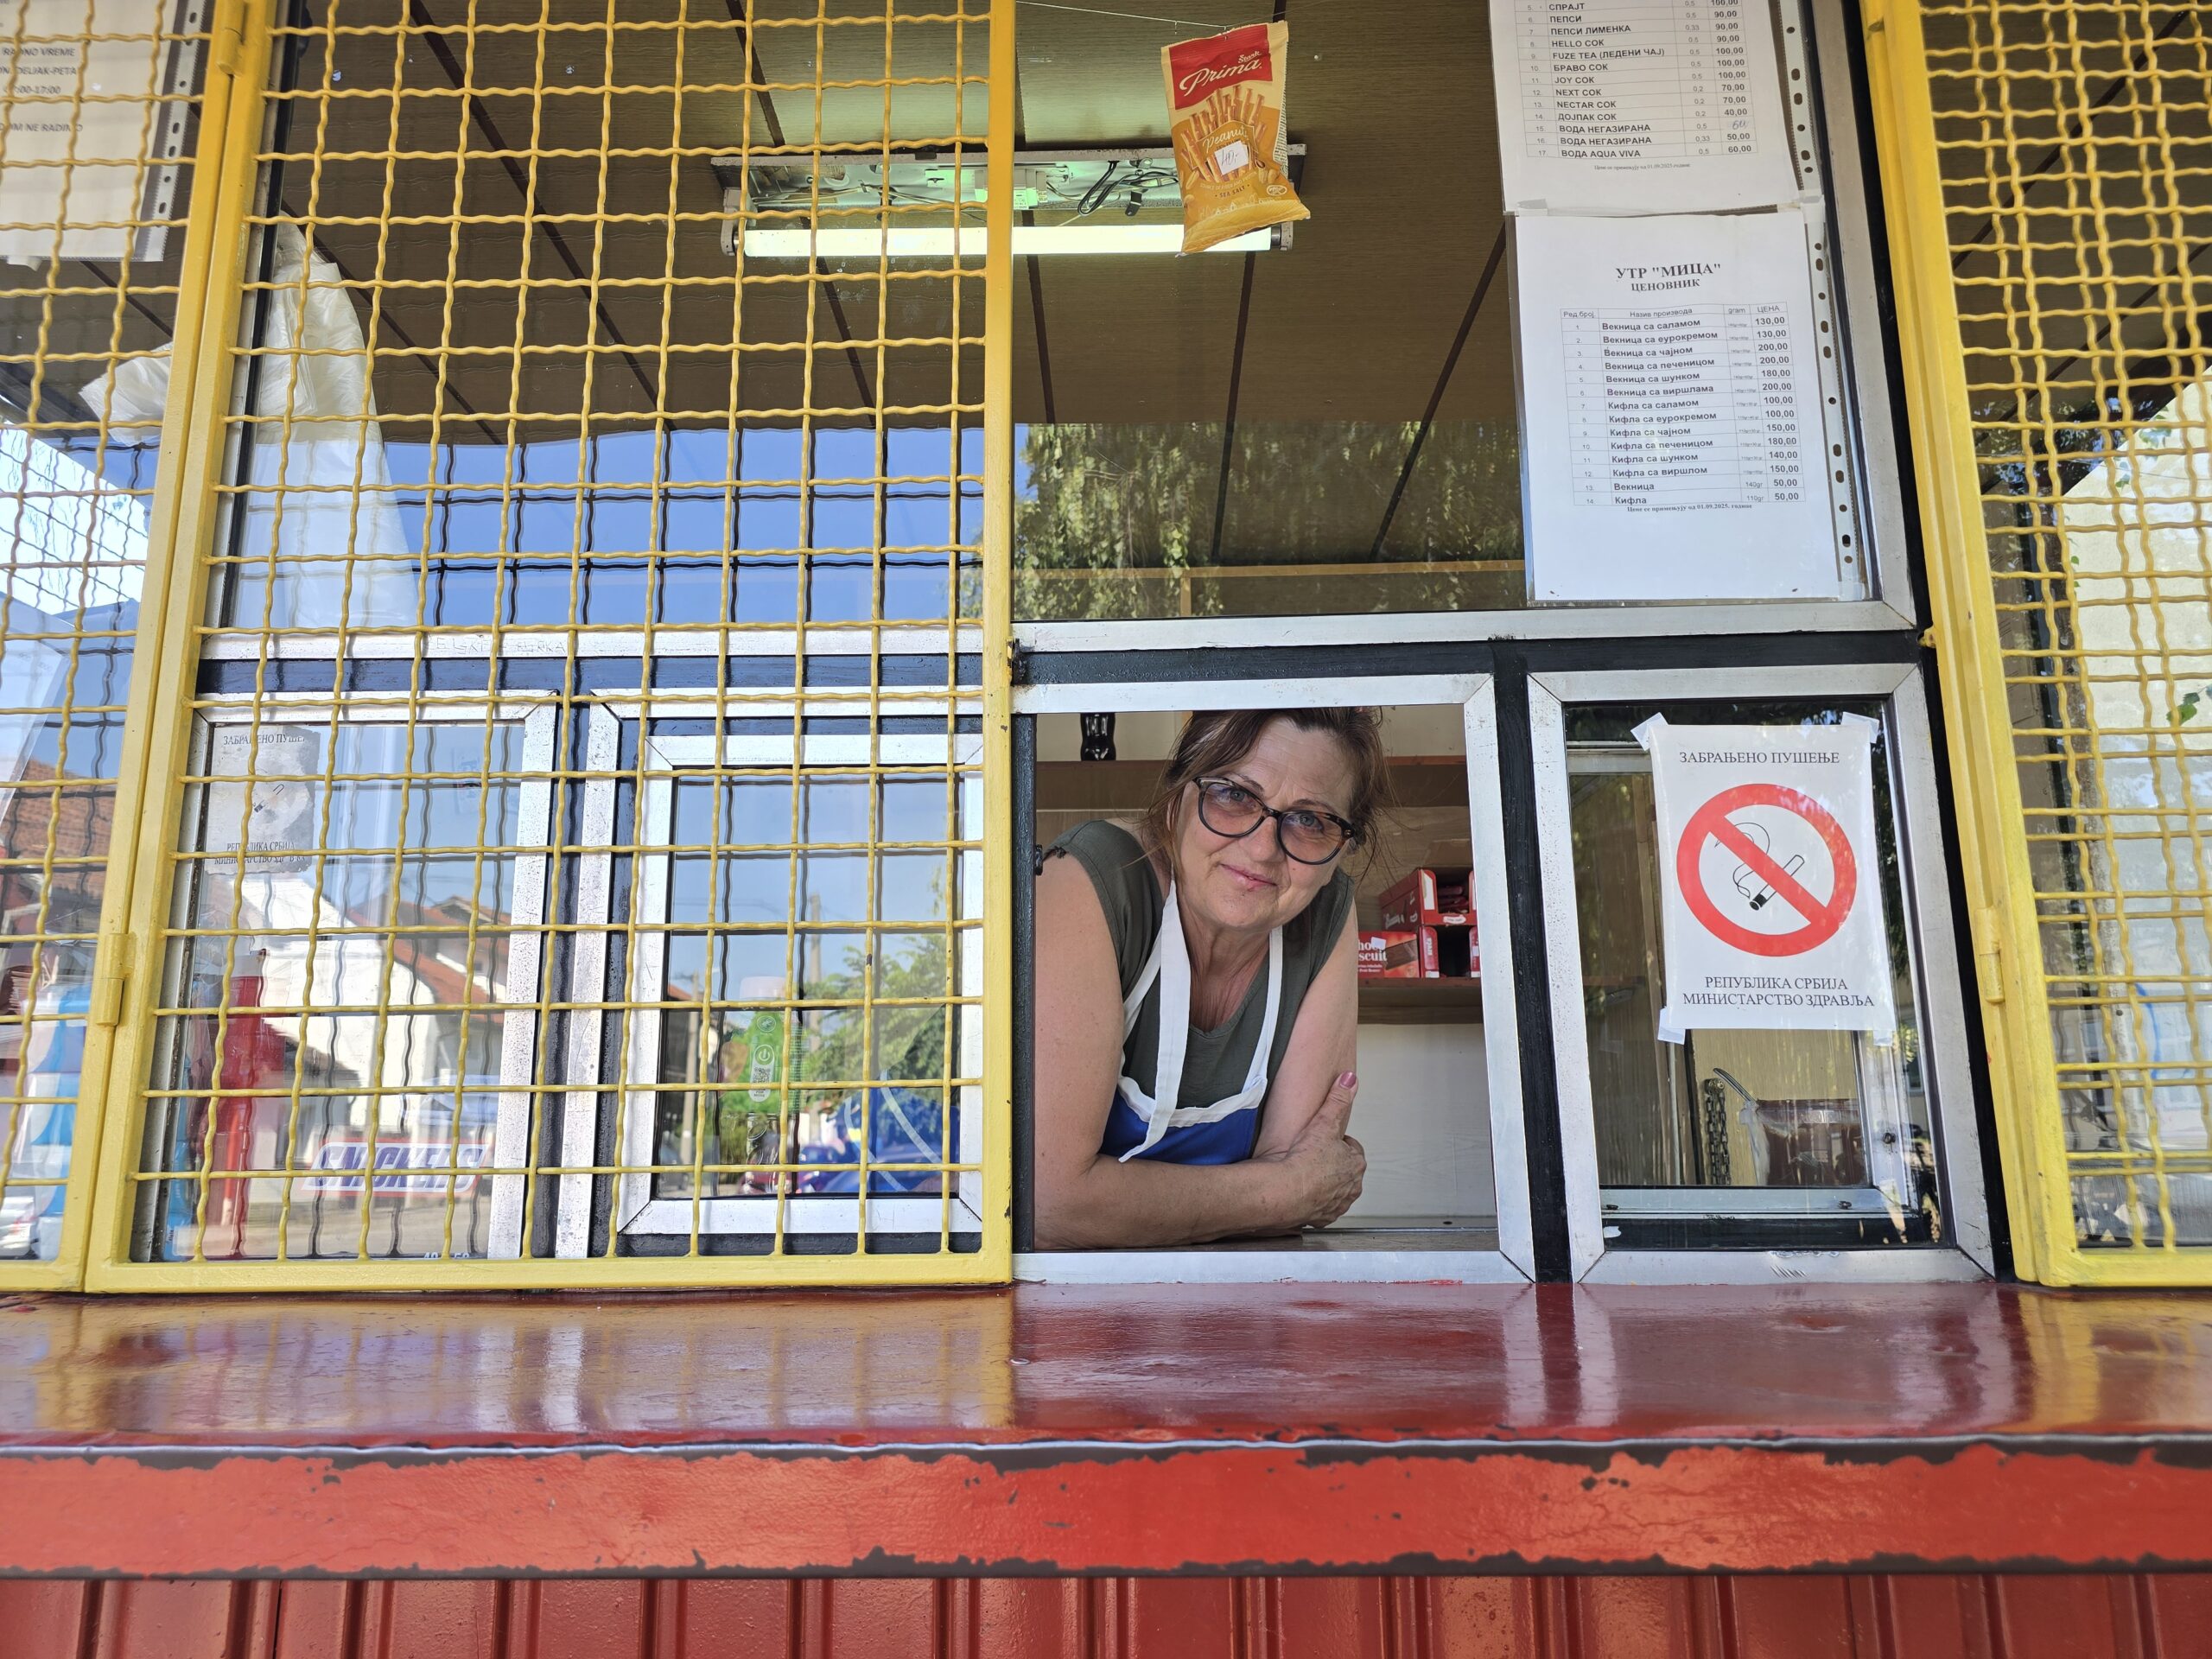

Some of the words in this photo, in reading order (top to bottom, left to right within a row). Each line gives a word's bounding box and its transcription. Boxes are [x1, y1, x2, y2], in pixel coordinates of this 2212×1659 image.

[1586, 25, 1630, 35] ЛИМЕНКА
[1599, 49, 1641, 60] (ЛЕДЕНИ
[1179, 59, 1262, 97] Prima
[1719, 71, 1746, 79] 100,00
[1724, 108, 1748, 117] 40,00
[1559, 125, 1585, 134] ВОДА
[1587, 124, 1651, 133] НЕГАЗИРАНА
[1589, 137, 1652, 145] НЕГАЗИРАНА
[1561, 149, 1587, 158] ВОДА
[1728, 145, 1751, 154] 60,00
[1232, 186, 1245, 194] SALT
[1615, 267, 1647, 279] УТР
[1652, 263, 1721, 277] "МИЦА"
[1630, 278, 1700, 292] ЦЕНОВНИК
[1654, 308, 1693, 318] производа
[1757, 305, 1780, 314] ЦЕНА
[1656, 320, 1700, 329] саламом
[1658, 333, 1718, 344] еурокремом
[1659, 347, 1694, 357] чајном
[1758, 343, 1788, 352] 200,00
[1660, 359, 1715, 370] печеницом
[1759, 356, 1789, 365] 200,00
[1662, 373, 1700, 384] шунком
[1662, 386, 1714, 397] виршлама
[1608, 402, 1639, 410] Кифла
[1656, 413, 1717, 423] еурокремом
[1610, 429, 1642, 438] Кифла
[1657, 428, 1691, 436] чајном
[1611, 442, 1643, 451] Кифла
[1659, 440, 1713, 449] печеницом
[1768, 437, 1796, 446] 180,00
[1611, 456, 1643, 465] Кифла
[1660, 454, 1698, 464] шунком
[1769, 451, 1798, 460] 140,00
[1612, 469, 1645, 479] Кифла
[1661, 467, 1707, 478] виршлом
[1770, 465, 1799, 474] 150,00
[1773, 479, 1797, 487] 50,00
[1615, 497, 1647, 505] Кифла
[1774, 493, 1799, 501] 50,00
[1680, 752, 1768, 764] ЗАБРАЊЕНО
[1770, 752, 1840, 764] ПУШЕЊЕ
[1358, 951, 1388, 961] scuit
[1704, 976, 1792, 990] РЕПУБЛИКА
[1795, 976, 1848, 990] СРБИЈА
[1683, 993, 1803, 1007] МИНИСТАРСТВО
[1805, 995, 1875, 1008] ЗДРАВЉА
